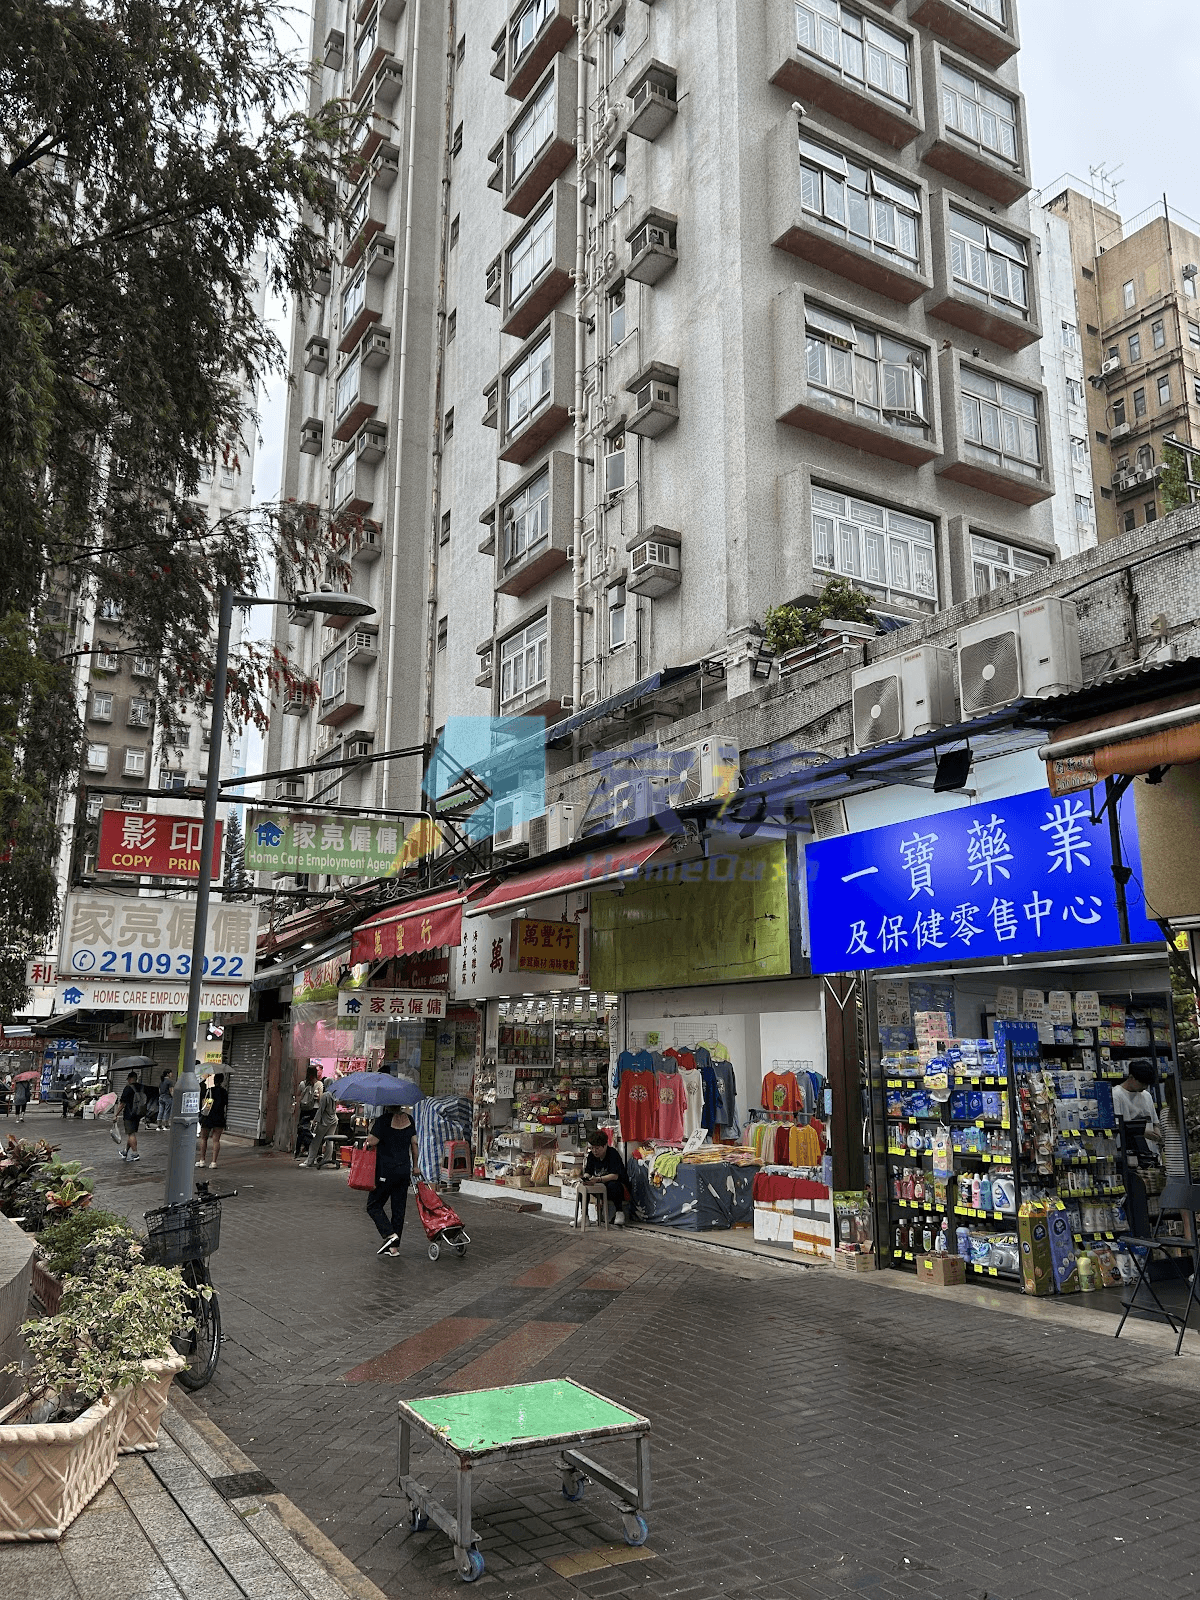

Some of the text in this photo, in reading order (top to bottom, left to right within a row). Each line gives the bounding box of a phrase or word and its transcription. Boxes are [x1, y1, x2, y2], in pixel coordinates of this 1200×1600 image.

[121, 816, 203, 854] 影印
[293, 821, 398, 854] 家亮僱傭
[111, 853, 201, 871] COPY PRIN
[248, 850, 401, 873] Home Care Employment Agency
[841, 799, 1093, 900] 一寶藥業
[70, 901, 252, 954] 家亮僱傭
[846, 890, 1103, 955] 及保健零售中心
[523, 924, 574, 949] 萬豐行
[429, 973, 449, 985] AGENCY
[93, 990, 244, 1007] HOME CARE EMPLOYNT AGENCY
[370, 997, 441, 1015] 家亮僱傭
